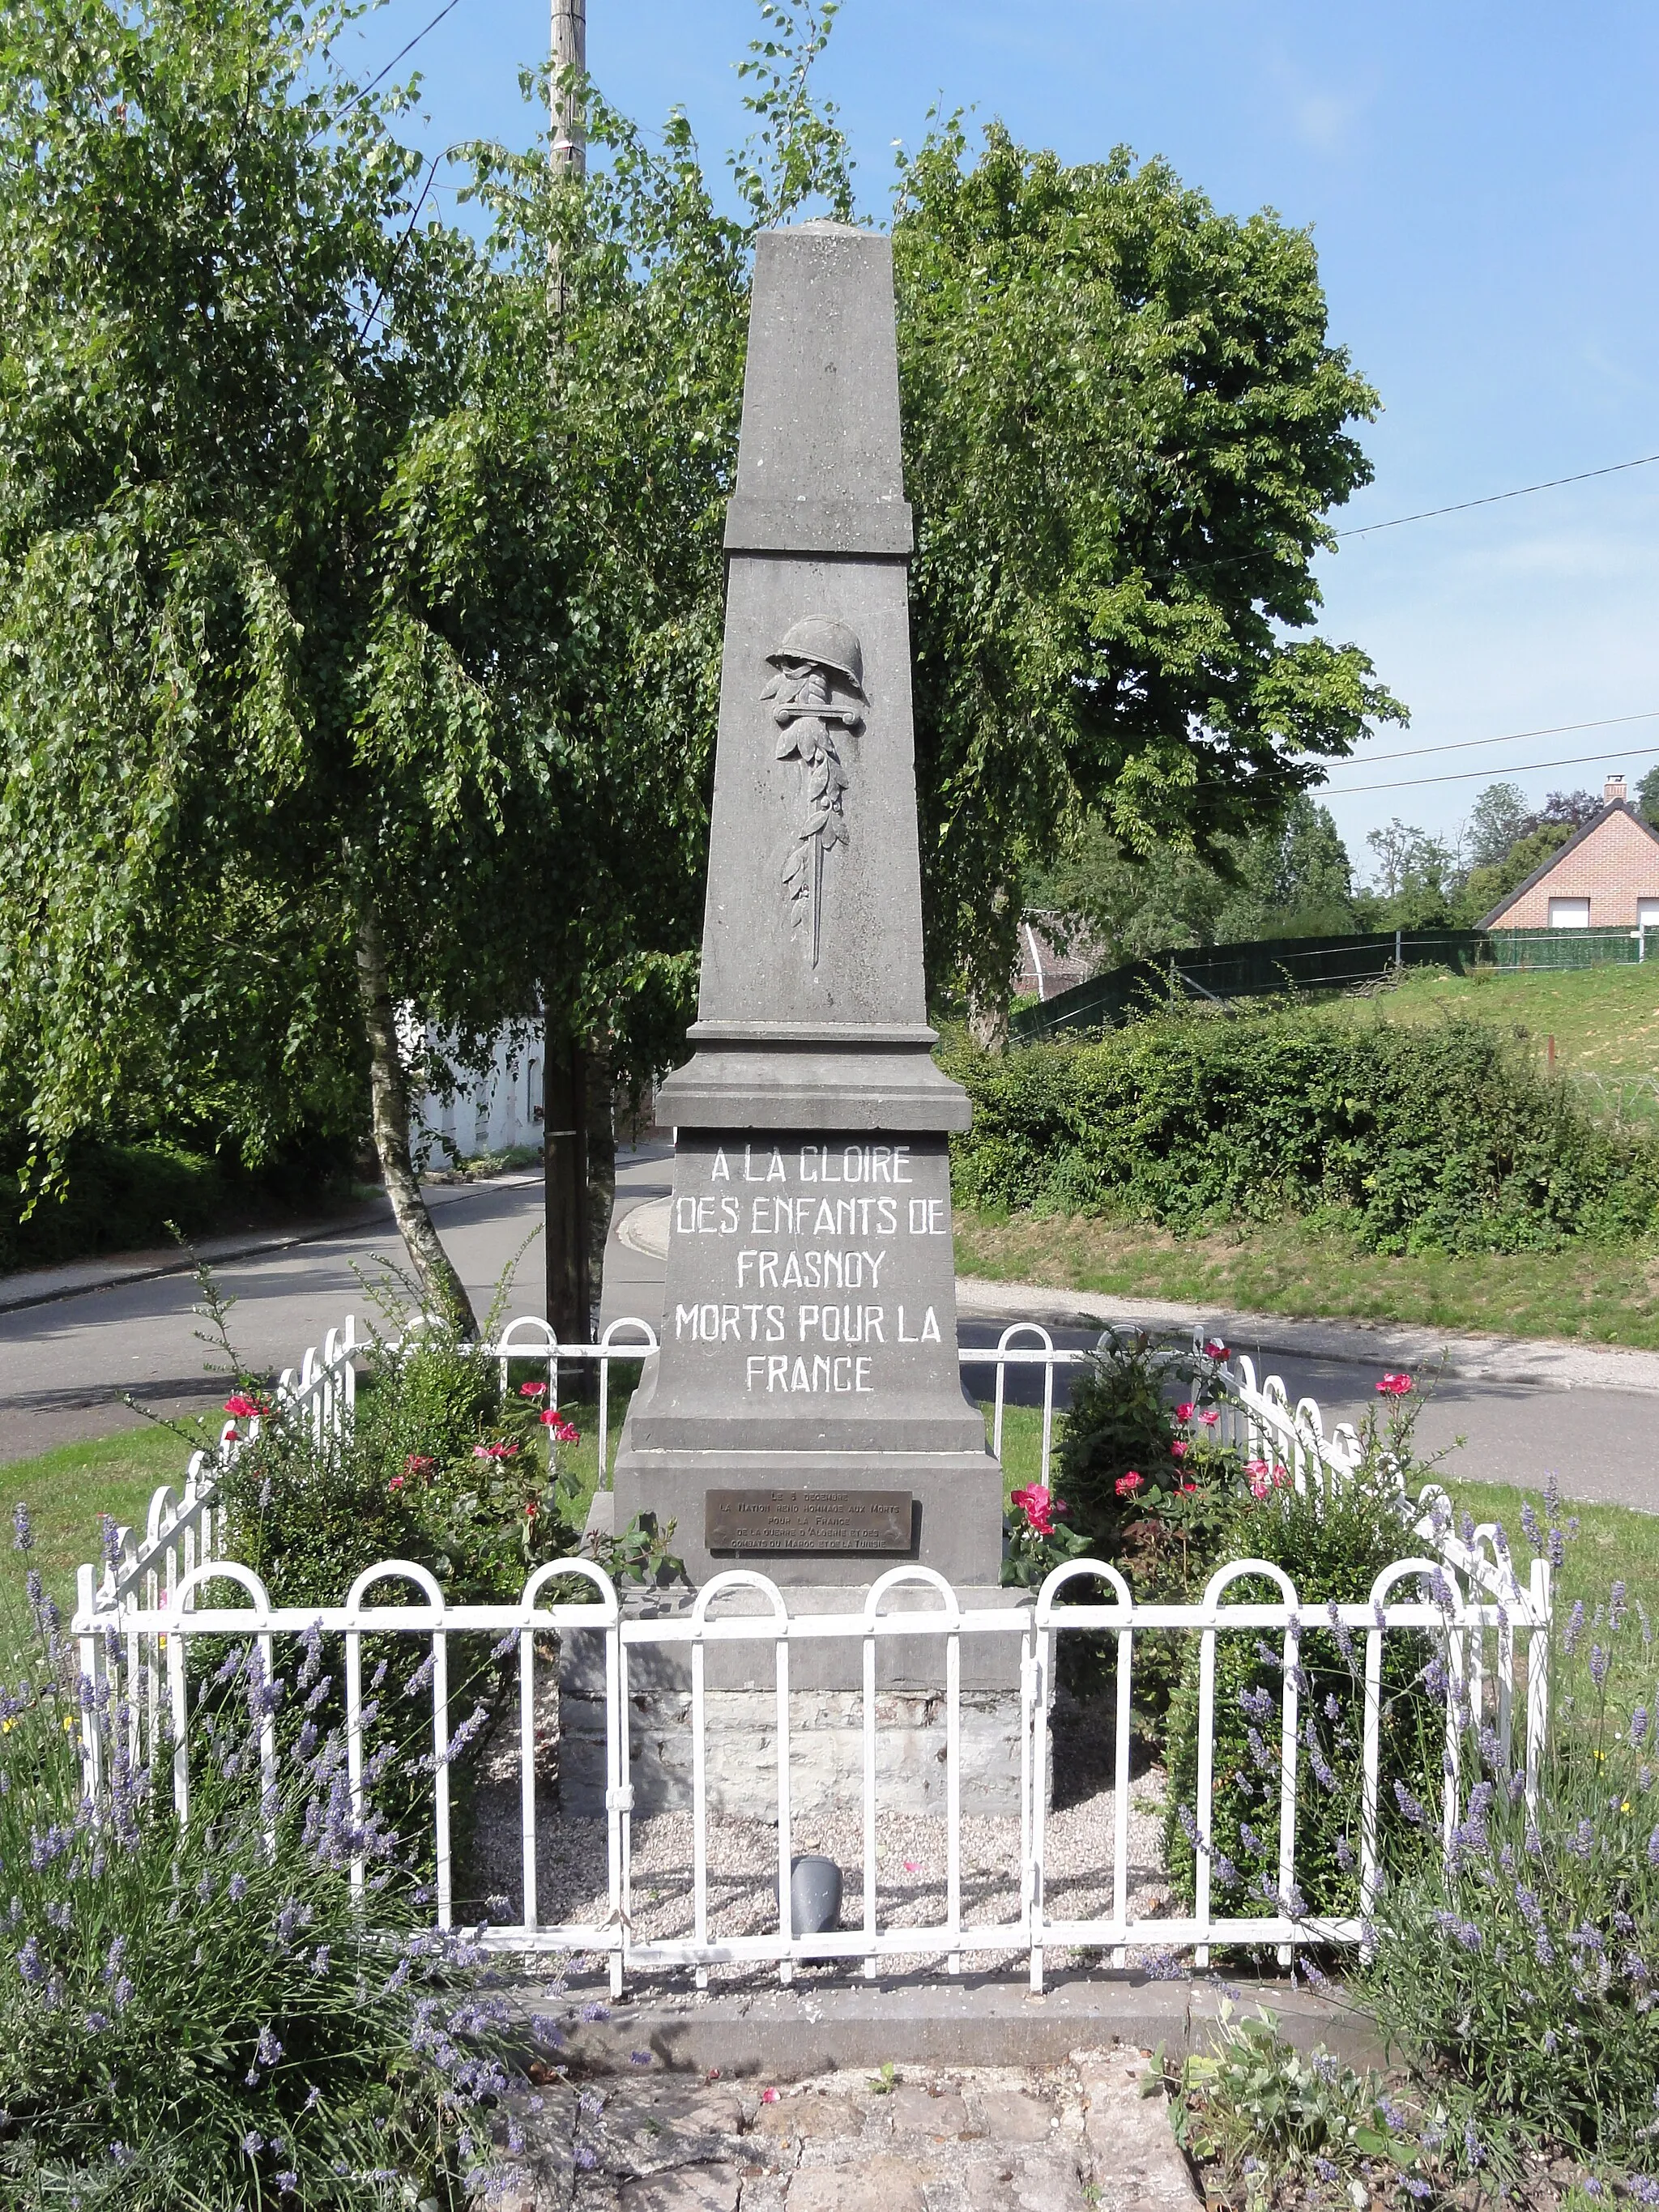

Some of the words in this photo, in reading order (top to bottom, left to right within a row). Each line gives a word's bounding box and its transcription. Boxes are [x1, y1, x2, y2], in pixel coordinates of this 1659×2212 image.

[711, 1147, 730, 1182] A
[744, 1144, 786, 1182] LA
[800, 1145, 913, 1183] GLOIRE
[676, 1196, 739, 1234] DES
[751, 1196, 897, 1235] ENFANTS
[909, 1198, 946, 1235] DE
[736, 1250, 886, 1289] FRASNOY
[676, 1304, 784, 1341] MORTS
[799, 1305, 884, 1343] POUR
[898, 1306, 941, 1343] LA
[746, 1355, 874, 1392] FRANCE
